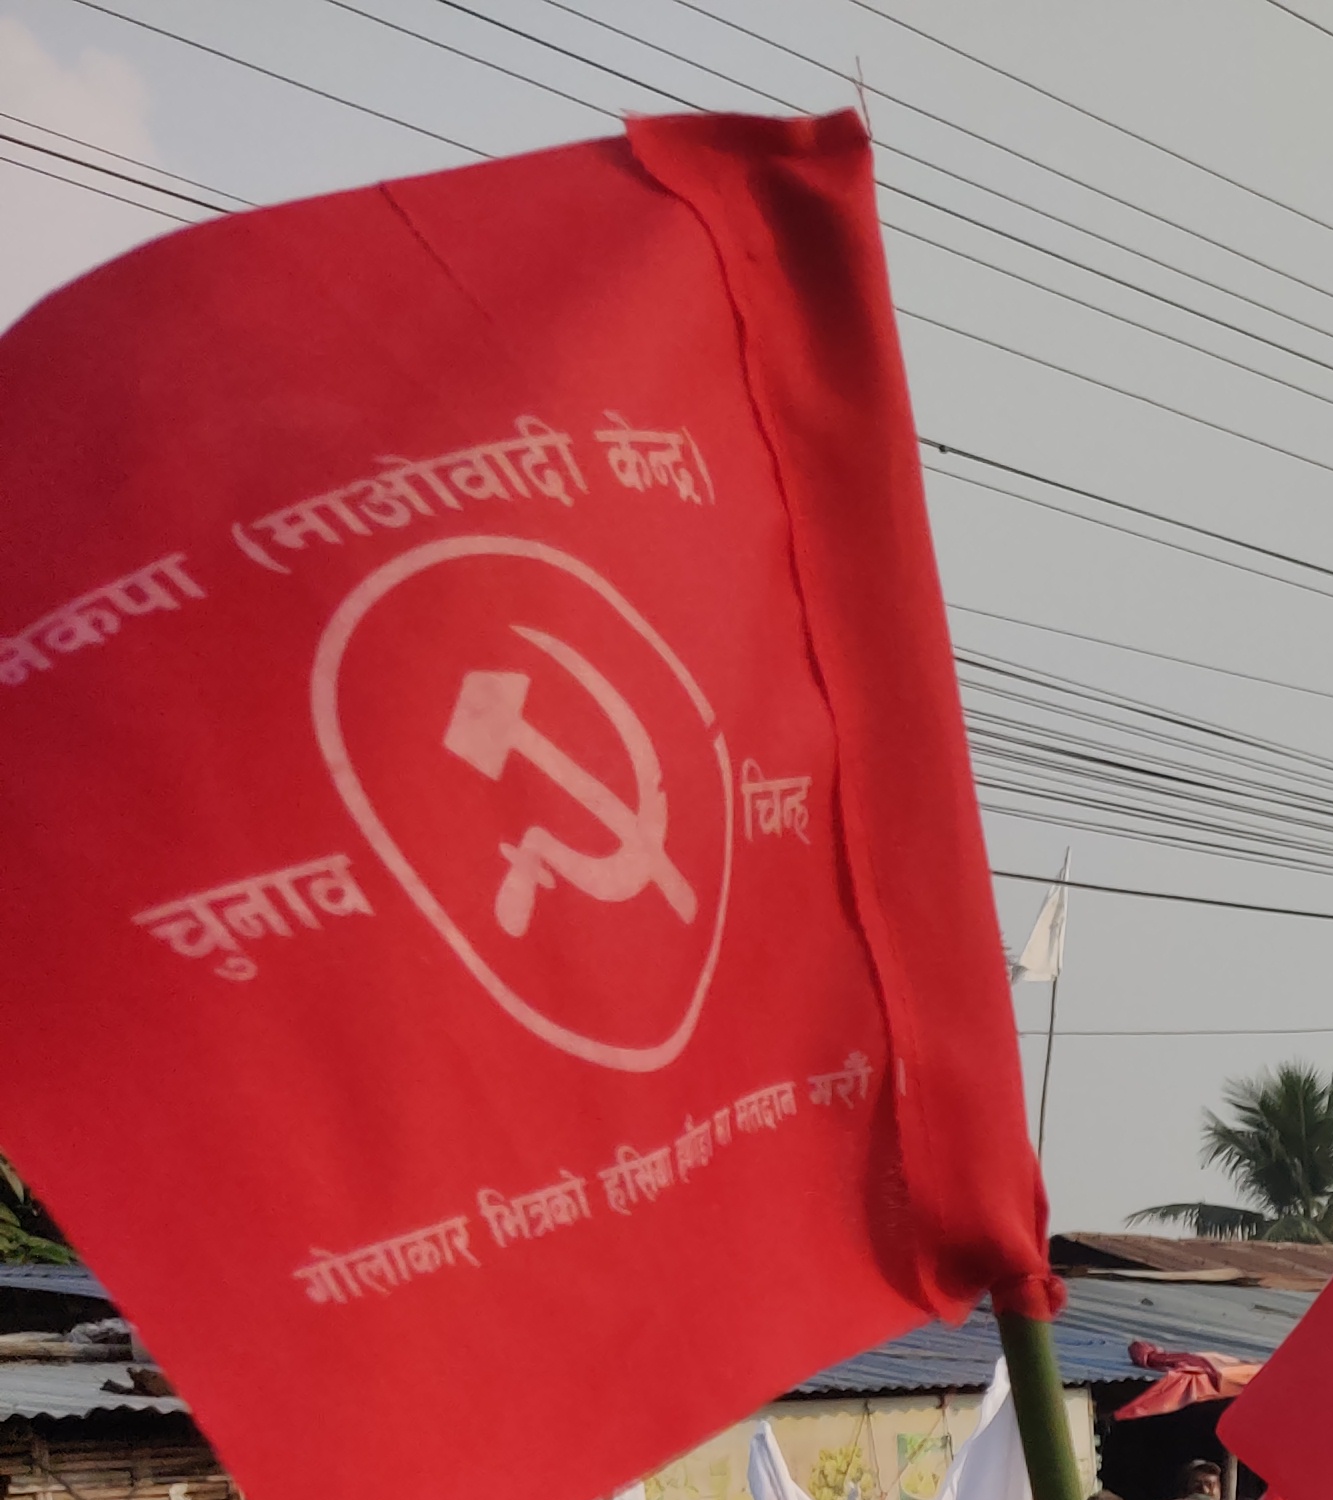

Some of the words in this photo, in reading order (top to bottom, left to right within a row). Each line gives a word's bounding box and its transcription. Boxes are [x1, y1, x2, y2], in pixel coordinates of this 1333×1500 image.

[131, 853, 375, 982] चुनाव
[292, 1215, 480, 1304] गोलाकार
[476, 1168, 592, 1248] भित्रको
